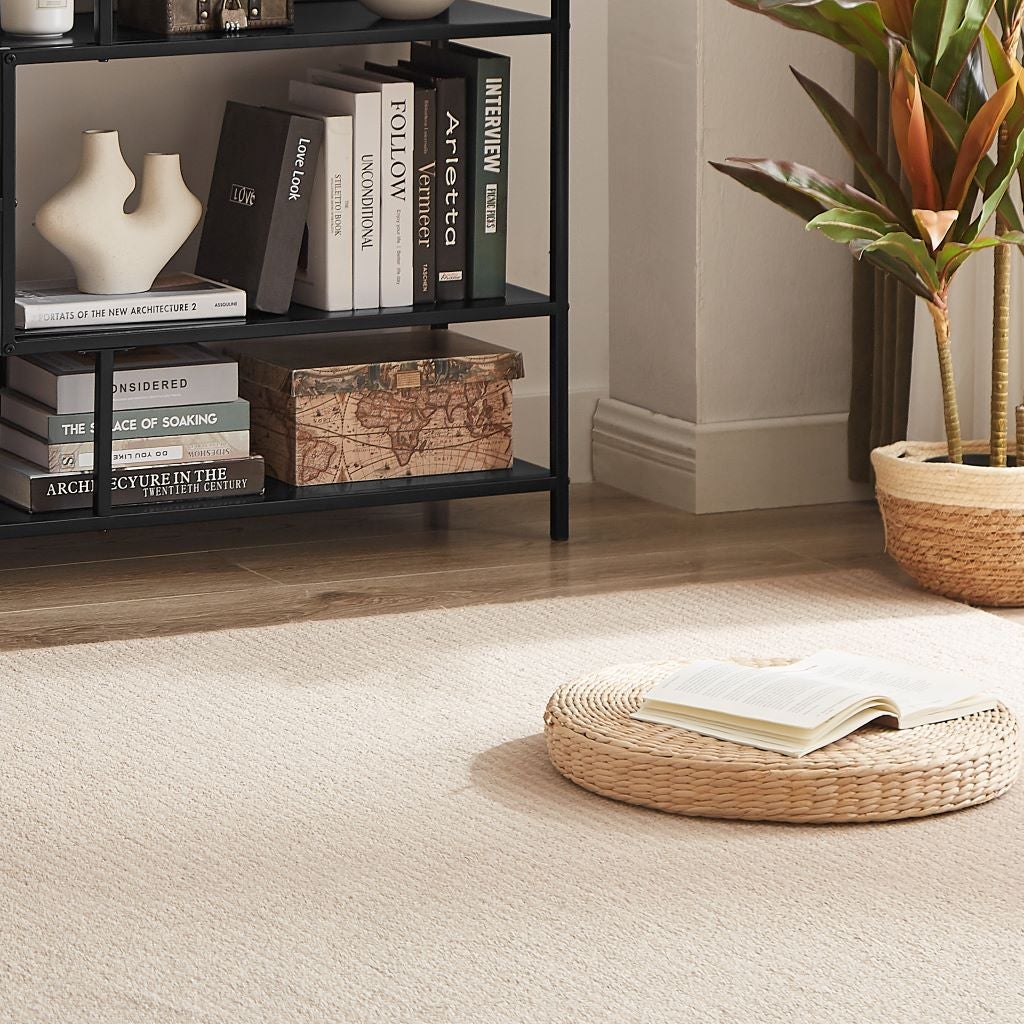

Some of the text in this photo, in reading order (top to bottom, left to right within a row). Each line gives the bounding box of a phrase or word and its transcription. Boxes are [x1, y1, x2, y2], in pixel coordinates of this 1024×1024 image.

[390, 99, 407, 201] FOLLOW
[484, 78, 503, 174] INTERVIEW
[288, 138, 311, 201] Love Look
[445, 111, 460, 246] Arletta
[334, 174, 342, 237] STILETTO BOOK
[361, 154, 374, 251] UNCONDITIONAL
[418, 161, 436, 248] Vermeer
[77, 310, 89, 320] OF
[91, 309, 106, 318] THE
[108, 307, 128, 317] NEW
[130, 303, 189, 315] ARCHITECTURE
[191, 302, 197, 311] 2
[112, 378, 188, 394] ONSIDERED
[62, 423, 86, 436] THE
[141, 418, 158, 430] OF
[162, 413, 218, 428] SOAKING
[46, 467, 227, 496] ARCHIECYURE IN THE
[143, 478, 248, 498] TWENTIETH CENTURY
